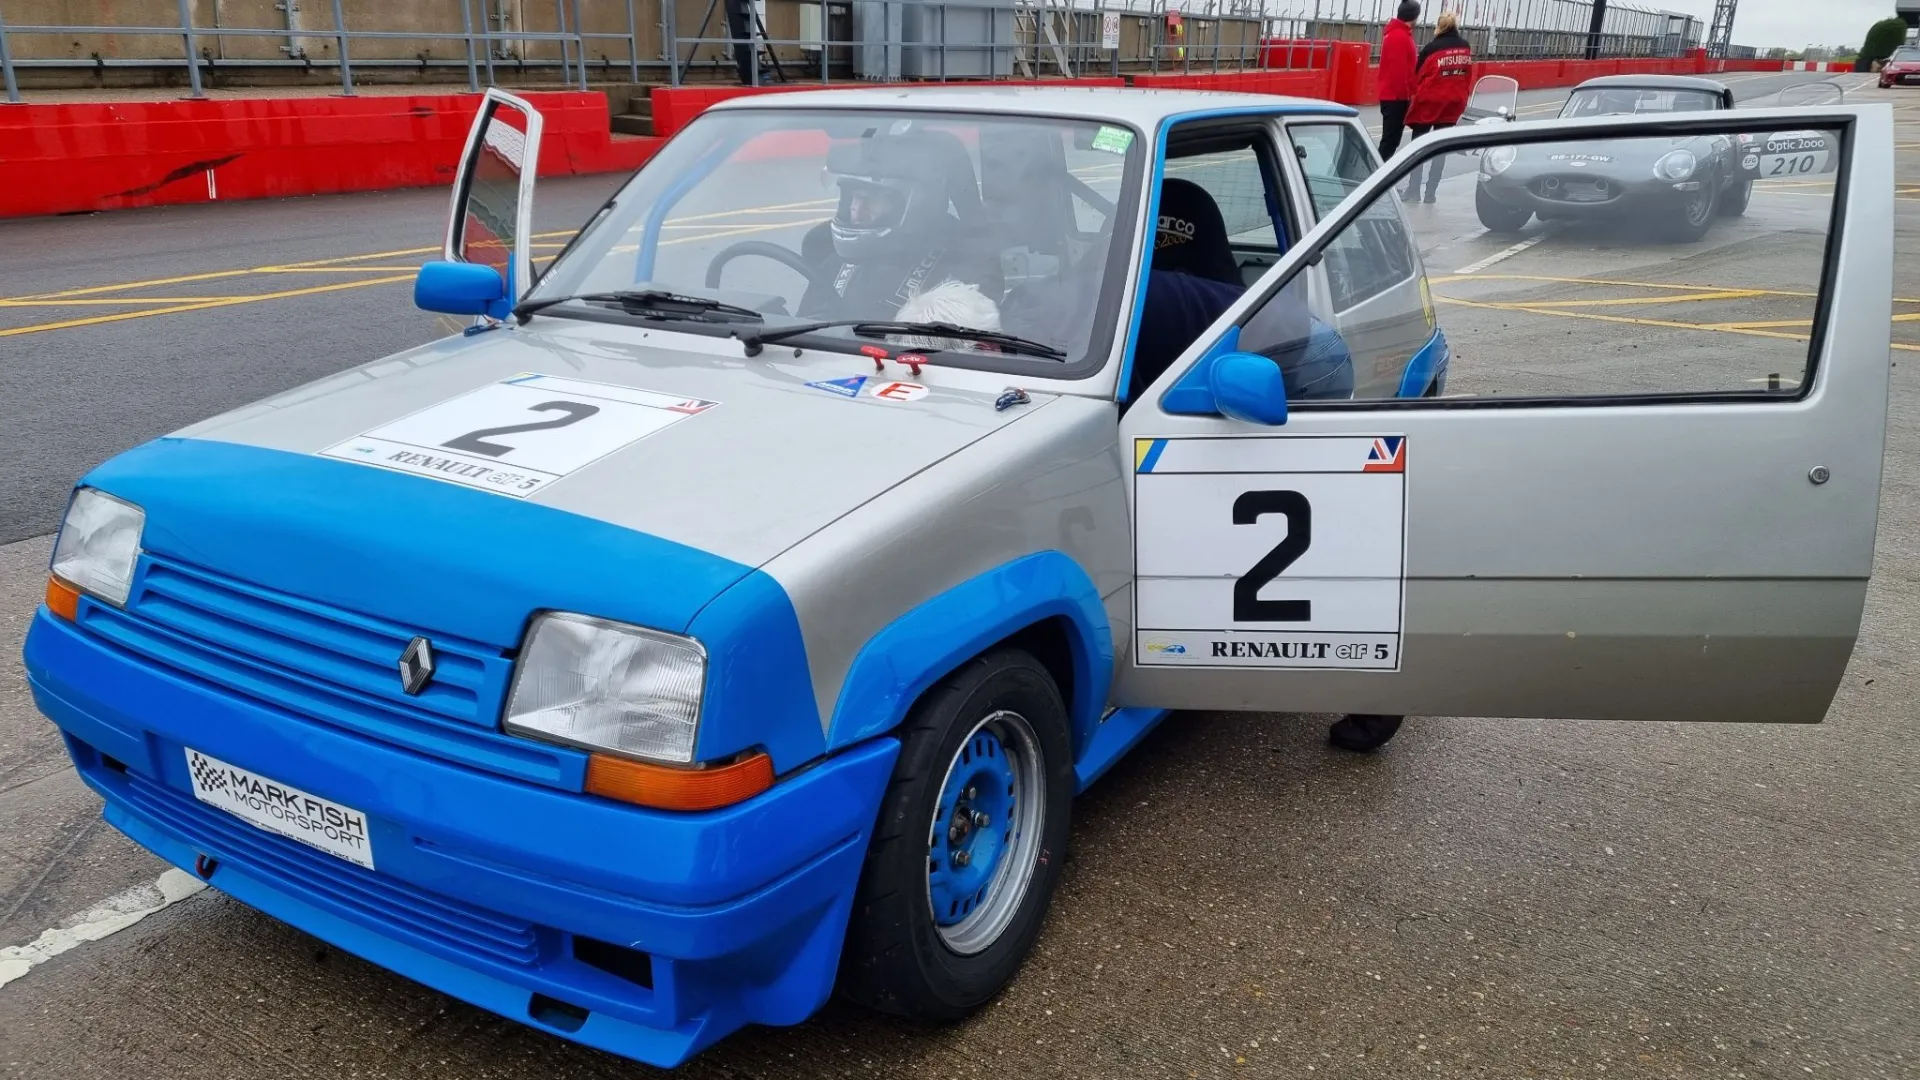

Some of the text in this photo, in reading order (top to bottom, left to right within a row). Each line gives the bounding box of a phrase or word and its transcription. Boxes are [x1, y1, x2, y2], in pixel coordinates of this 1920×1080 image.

[1767, 140, 1796, 153] Optic
[1770, 155, 1815, 175] 210
[876, 383, 924, 400] E
[439, 400, 600, 458] 2
[386, 450, 494, 478] RENAULT
[517, 478, 541, 490] 5
[1233, 490, 1311, 622] 2
[1211, 641, 1331, 659] RENAULT
[1335, 643, 1368, 659] elf
[1374, 643, 1389, 660] 5
[229, 770, 364, 836] MARK FISH
[233, 790, 365, 849] MOTORSPORT
